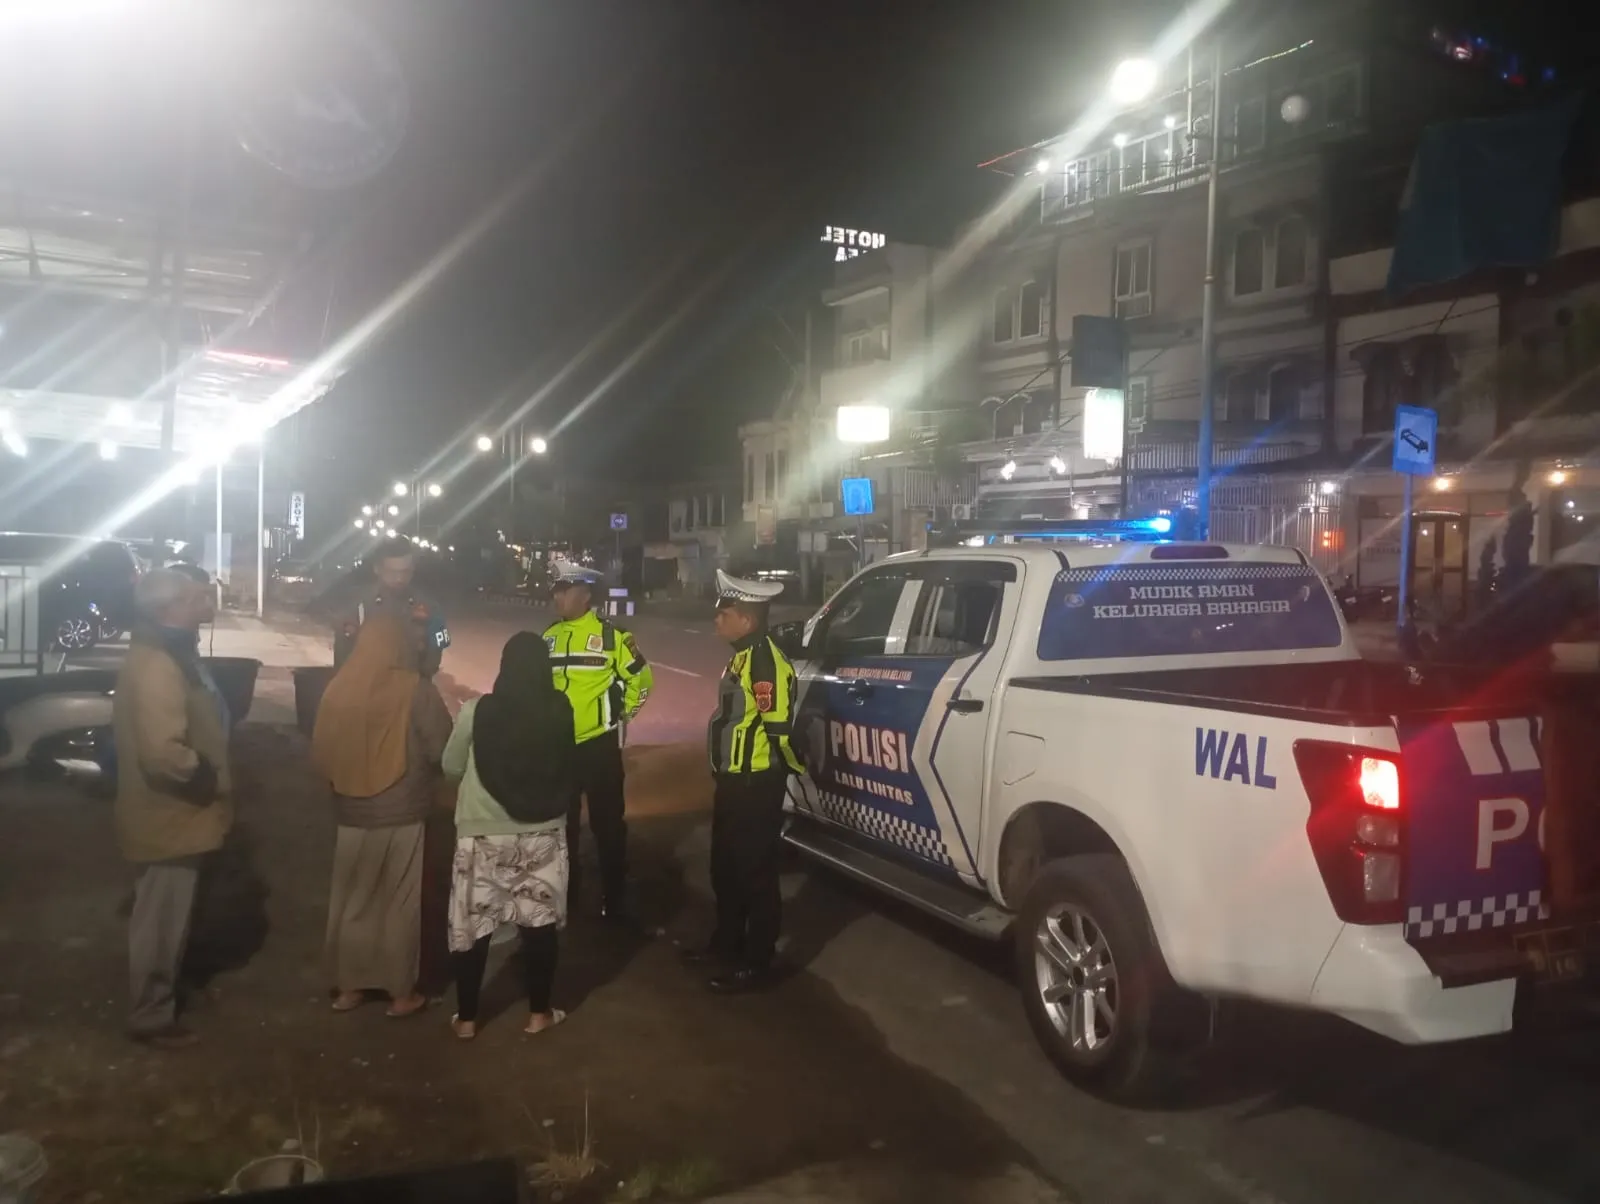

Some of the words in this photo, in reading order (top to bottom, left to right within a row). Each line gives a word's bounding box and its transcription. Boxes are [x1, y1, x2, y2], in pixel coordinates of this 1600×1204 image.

[1093, 603, 1203, 618] KELUARGA
[1207, 600, 1291, 615] BAHAGIA
[1129, 585, 1194, 600] MUDIK
[1198, 584, 1254, 598] AMAN
[830, 719, 909, 774] POLISI
[1195, 727, 1277, 789] WAL
[835, 770, 865, 791] LALU
[866, 780, 914, 806] LINTAS
[1475, 797, 1546, 870] P
